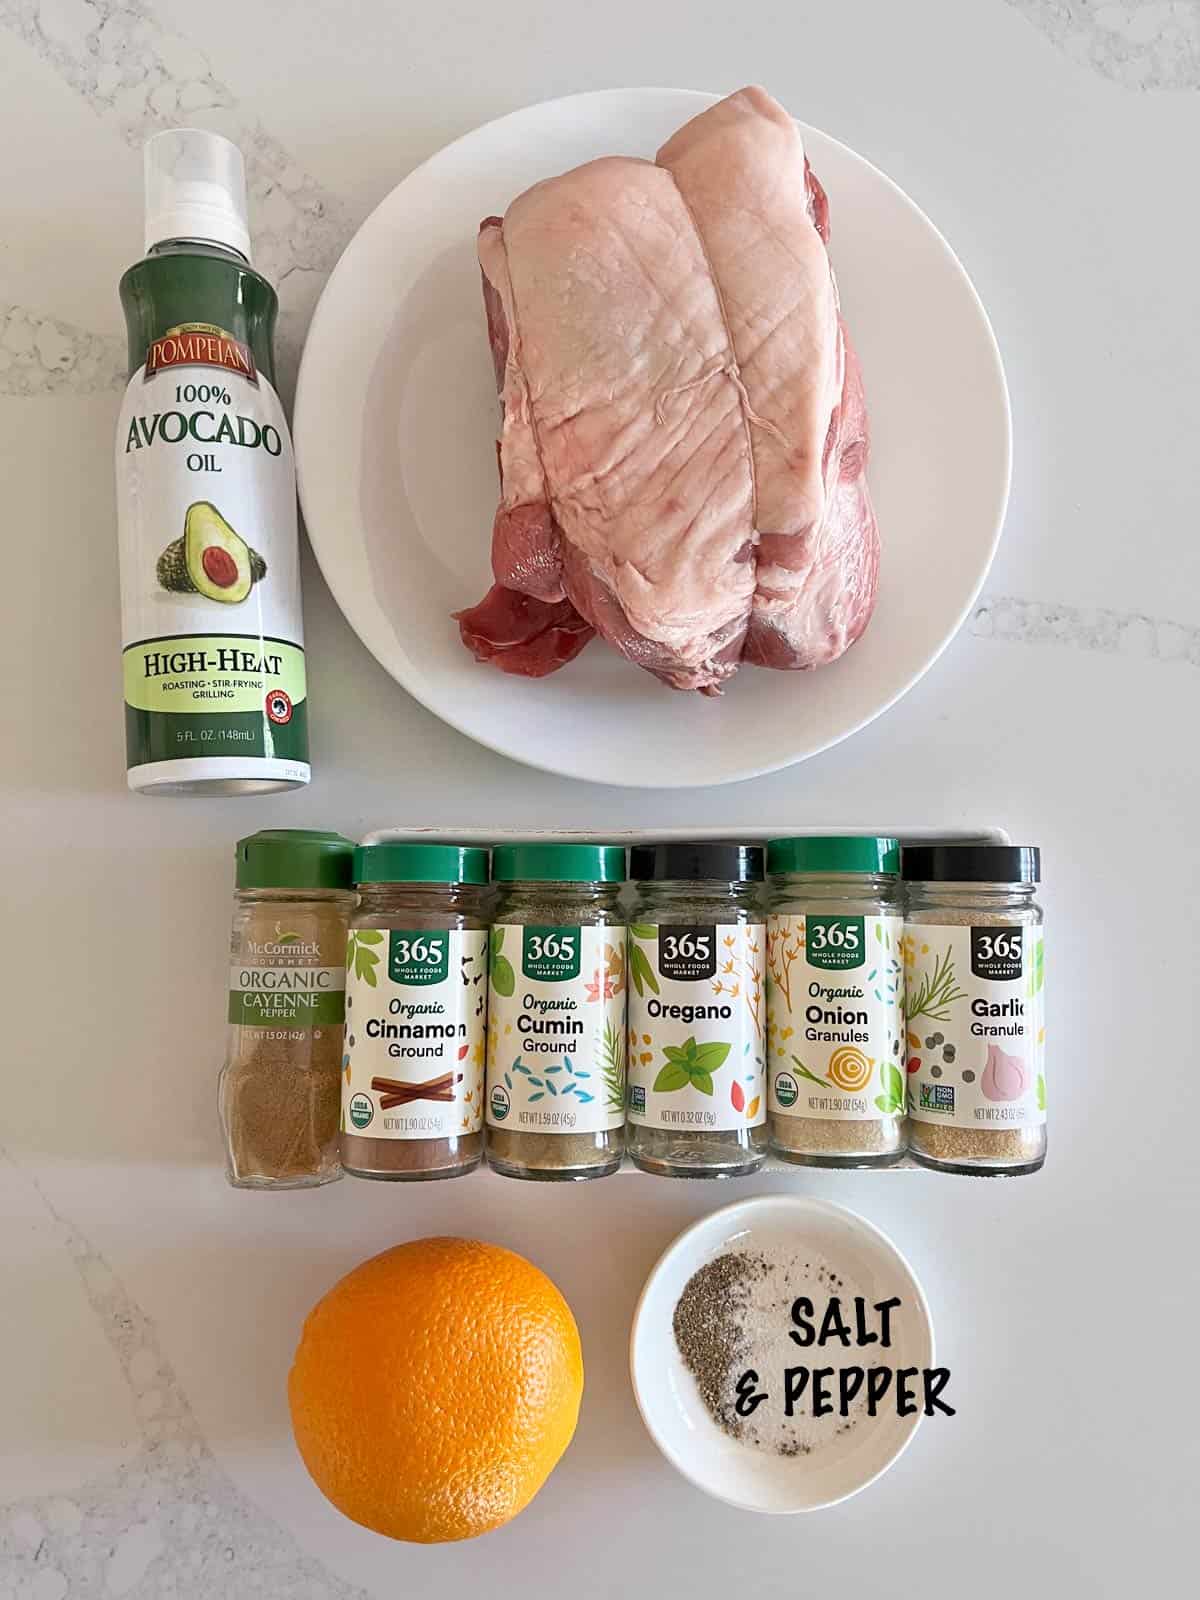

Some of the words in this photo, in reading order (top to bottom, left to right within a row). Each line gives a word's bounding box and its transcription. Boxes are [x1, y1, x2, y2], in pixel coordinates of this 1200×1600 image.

[152, 337, 250, 372] POMPEIAN
[176, 385, 231, 405] 100%
[126, 411, 282, 456] AVOCADO
[186, 454, 222, 472] OIL
[144, 649, 282, 677] HIGH-HEAT
[162, 680, 206, 691] ROASTING
[212, 680, 264, 689] STIR-FRYING
[192, 690, 235, 699] GRILLING
[176, 731, 183, 742] 5
[218, 729, 255, 741] (148mL)
[812, 922, 859, 950] 365
[248, 941, 320, 955] McCormick
[394, 936, 443, 965] 365
[527, 933, 575, 961] 365
[664, 933, 710, 960] 365
[977, 932, 1022, 960] 365
[240, 971, 330, 988] ORGANIC
[243, 993, 320, 1008] CAYENNE
[808, 982, 864, 1002] Organic
[260, 1008, 296, 1018] PEPPER
[389, 998, 445, 1020] Organic
[523, 994, 577, 1014] Organic
[648, 999, 732, 1023] Oregano
[517, 1015, 584, 1034] Cumin
[805, 1006, 868, 1025] Onion
[276, 1031, 287, 1040] OZ
[366, 1019, 467, 1039] Cinnamon
[805, 1028, 870, 1042] Granules
[971, 1022, 1024, 1036] Granule
[388, 1043, 443, 1057] Ground
[523, 1039, 577, 1053] Ground
